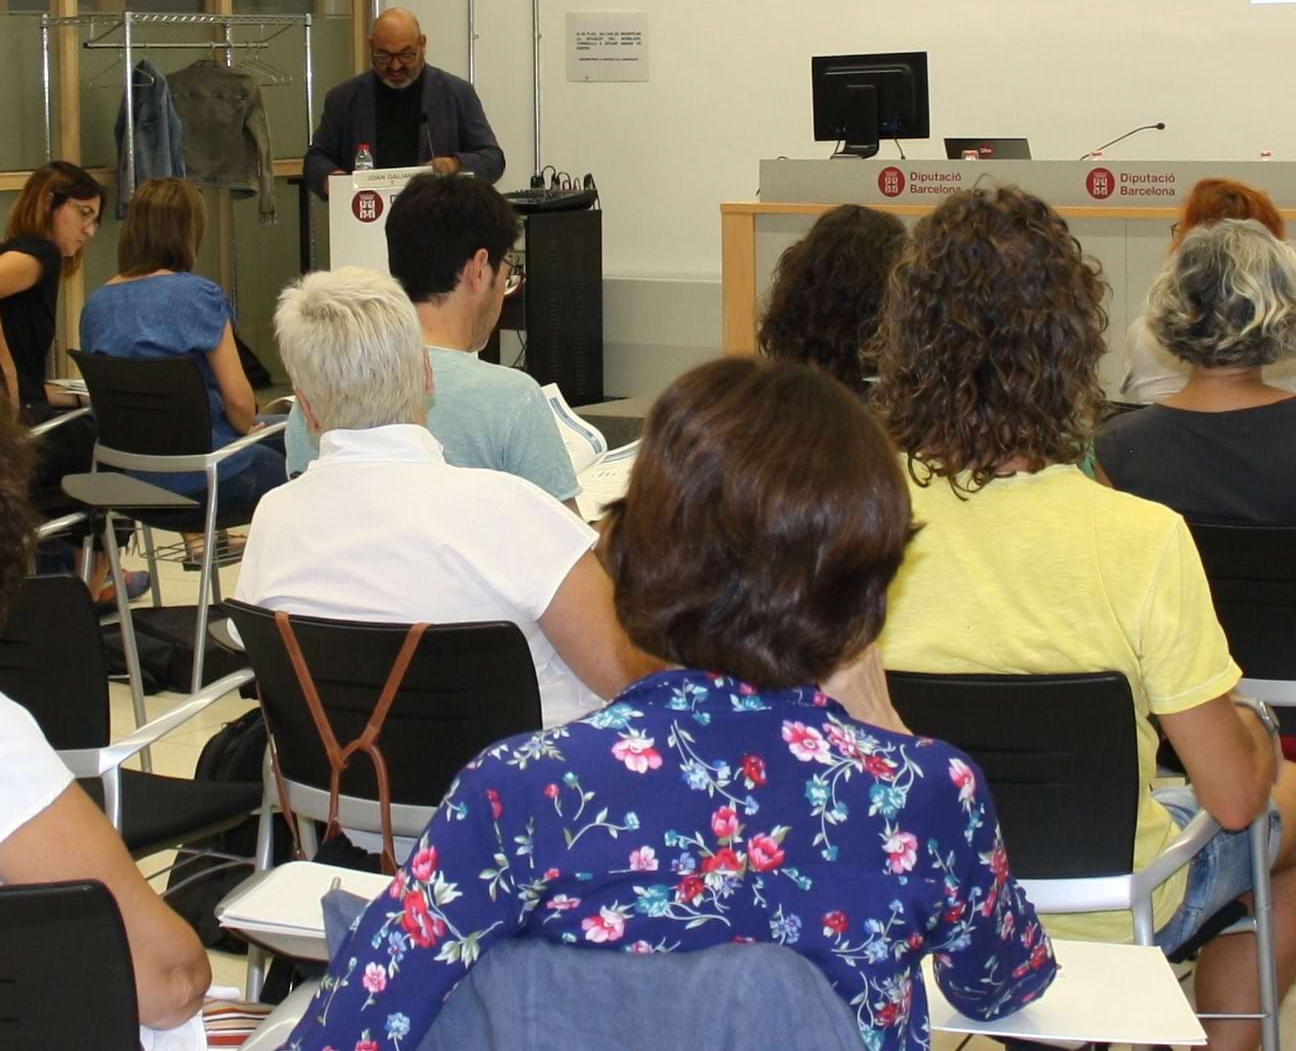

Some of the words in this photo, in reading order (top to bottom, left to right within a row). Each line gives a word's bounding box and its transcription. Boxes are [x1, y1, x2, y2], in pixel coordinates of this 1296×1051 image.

[910, 171, 962, 182] Diputació
[1120, 172, 1175, 185] Diputació
[1120, 186, 1175, 196] Barcelona
